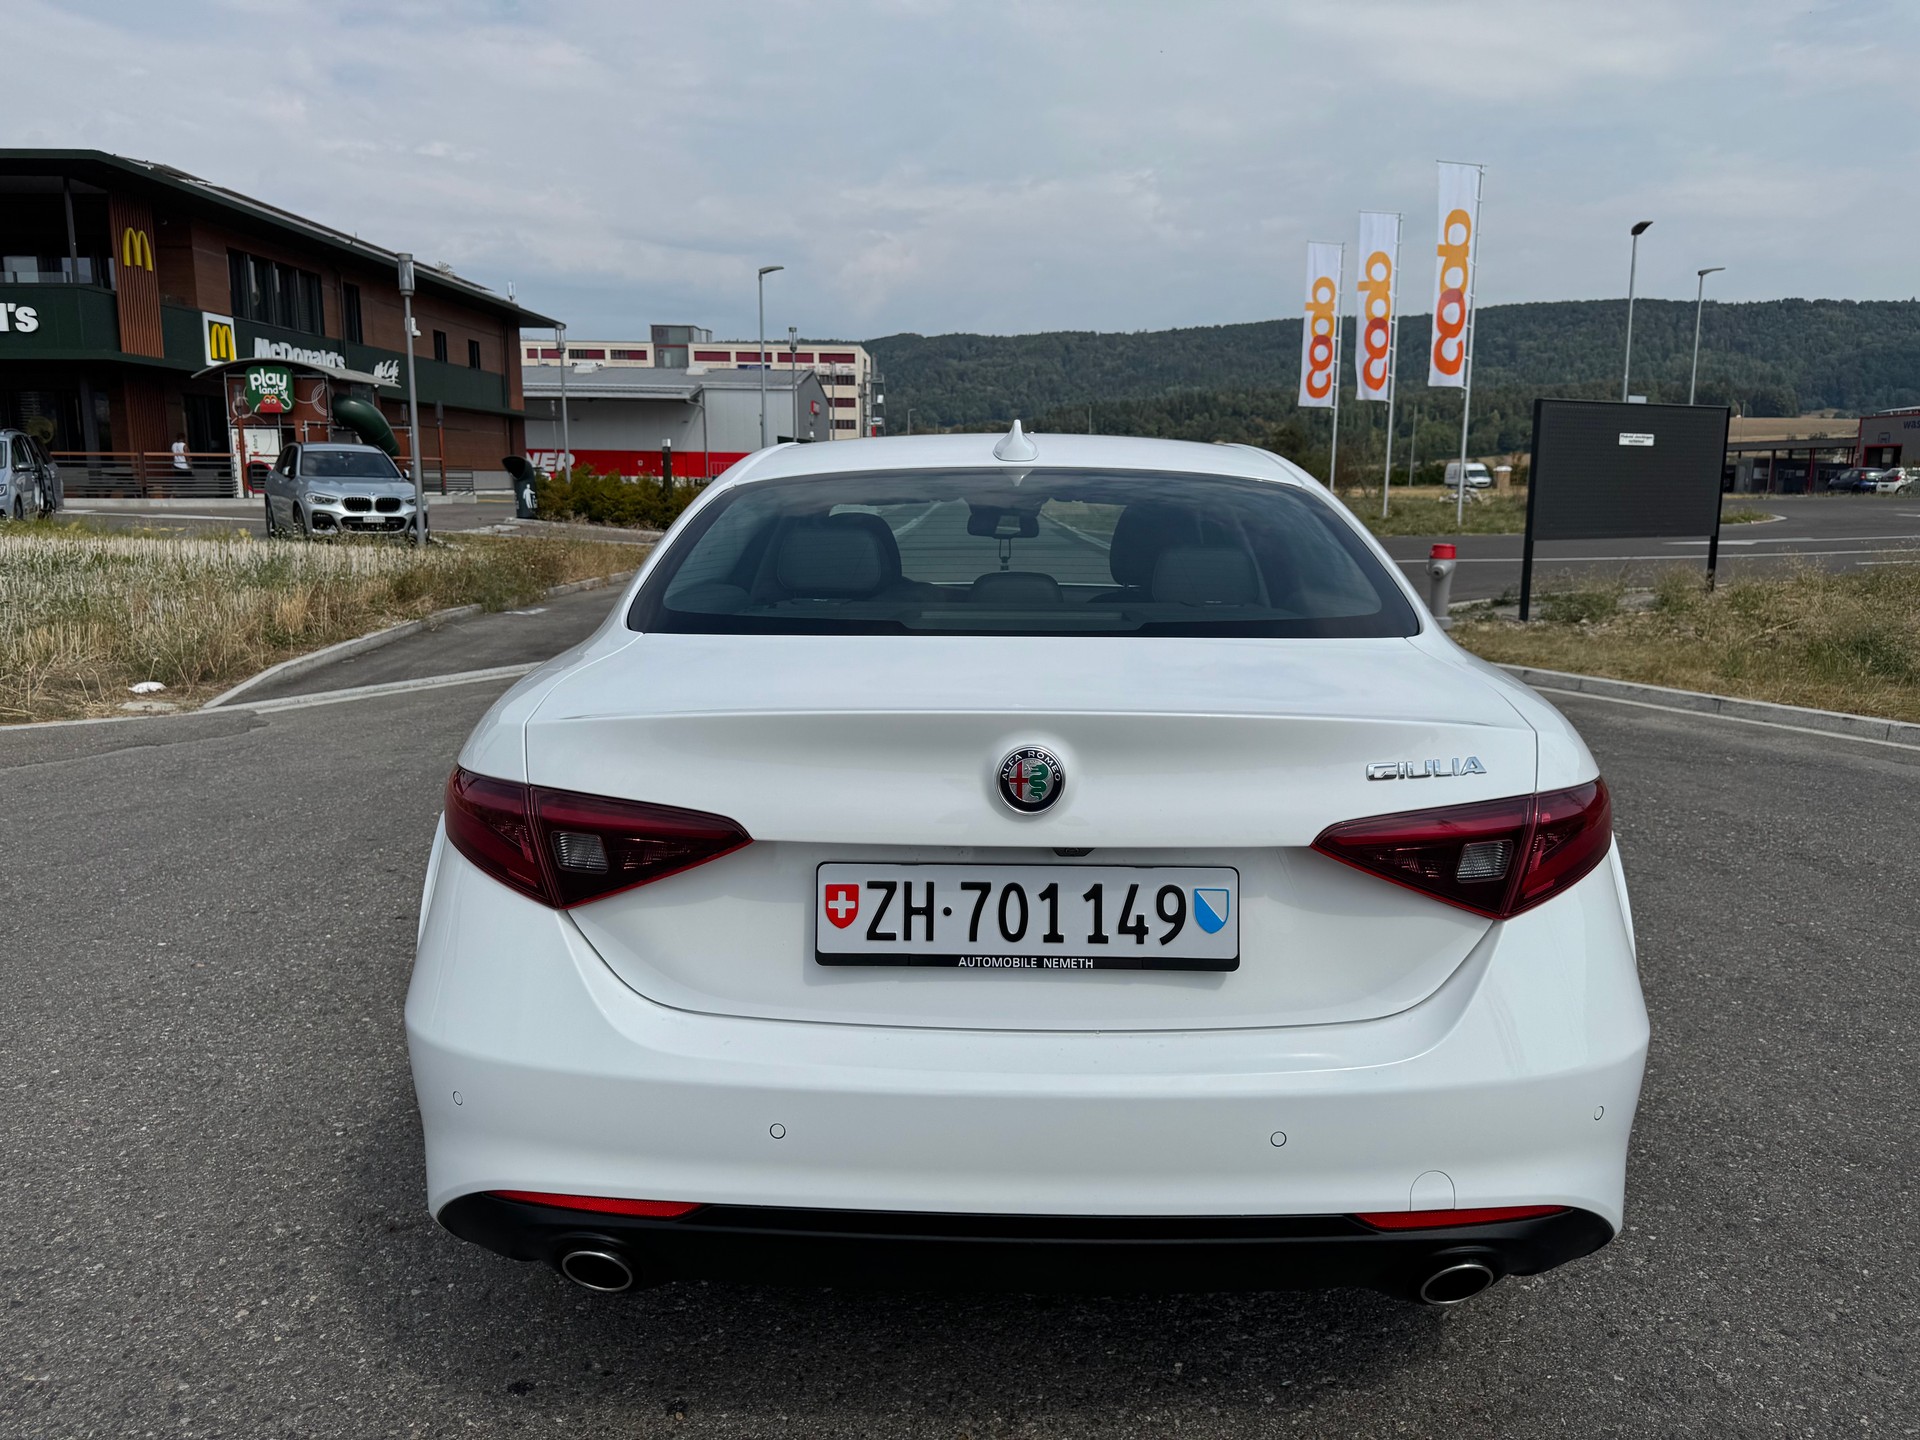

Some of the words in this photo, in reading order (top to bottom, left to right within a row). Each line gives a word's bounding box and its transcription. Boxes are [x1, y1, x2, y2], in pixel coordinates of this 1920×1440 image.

[1433, 209, 1472, 375] coop
[1357, 251, 1392, 391] coop
[1305, 276, 1335, 398] coop
[254, 337, 345, 369] McDonald's
[249, 368, 287, 391] play
[259, 386, 279, 394] land
[1002, 754, 1022, 780] ALFA
[1027, 750, 1061, 781] ROMEO
[1366, 757, 1487, 781] GIULIA
[958, 956, 1038, 968] AUTOMOBILE
[1043, 957, 1094, 969] NEMETH
